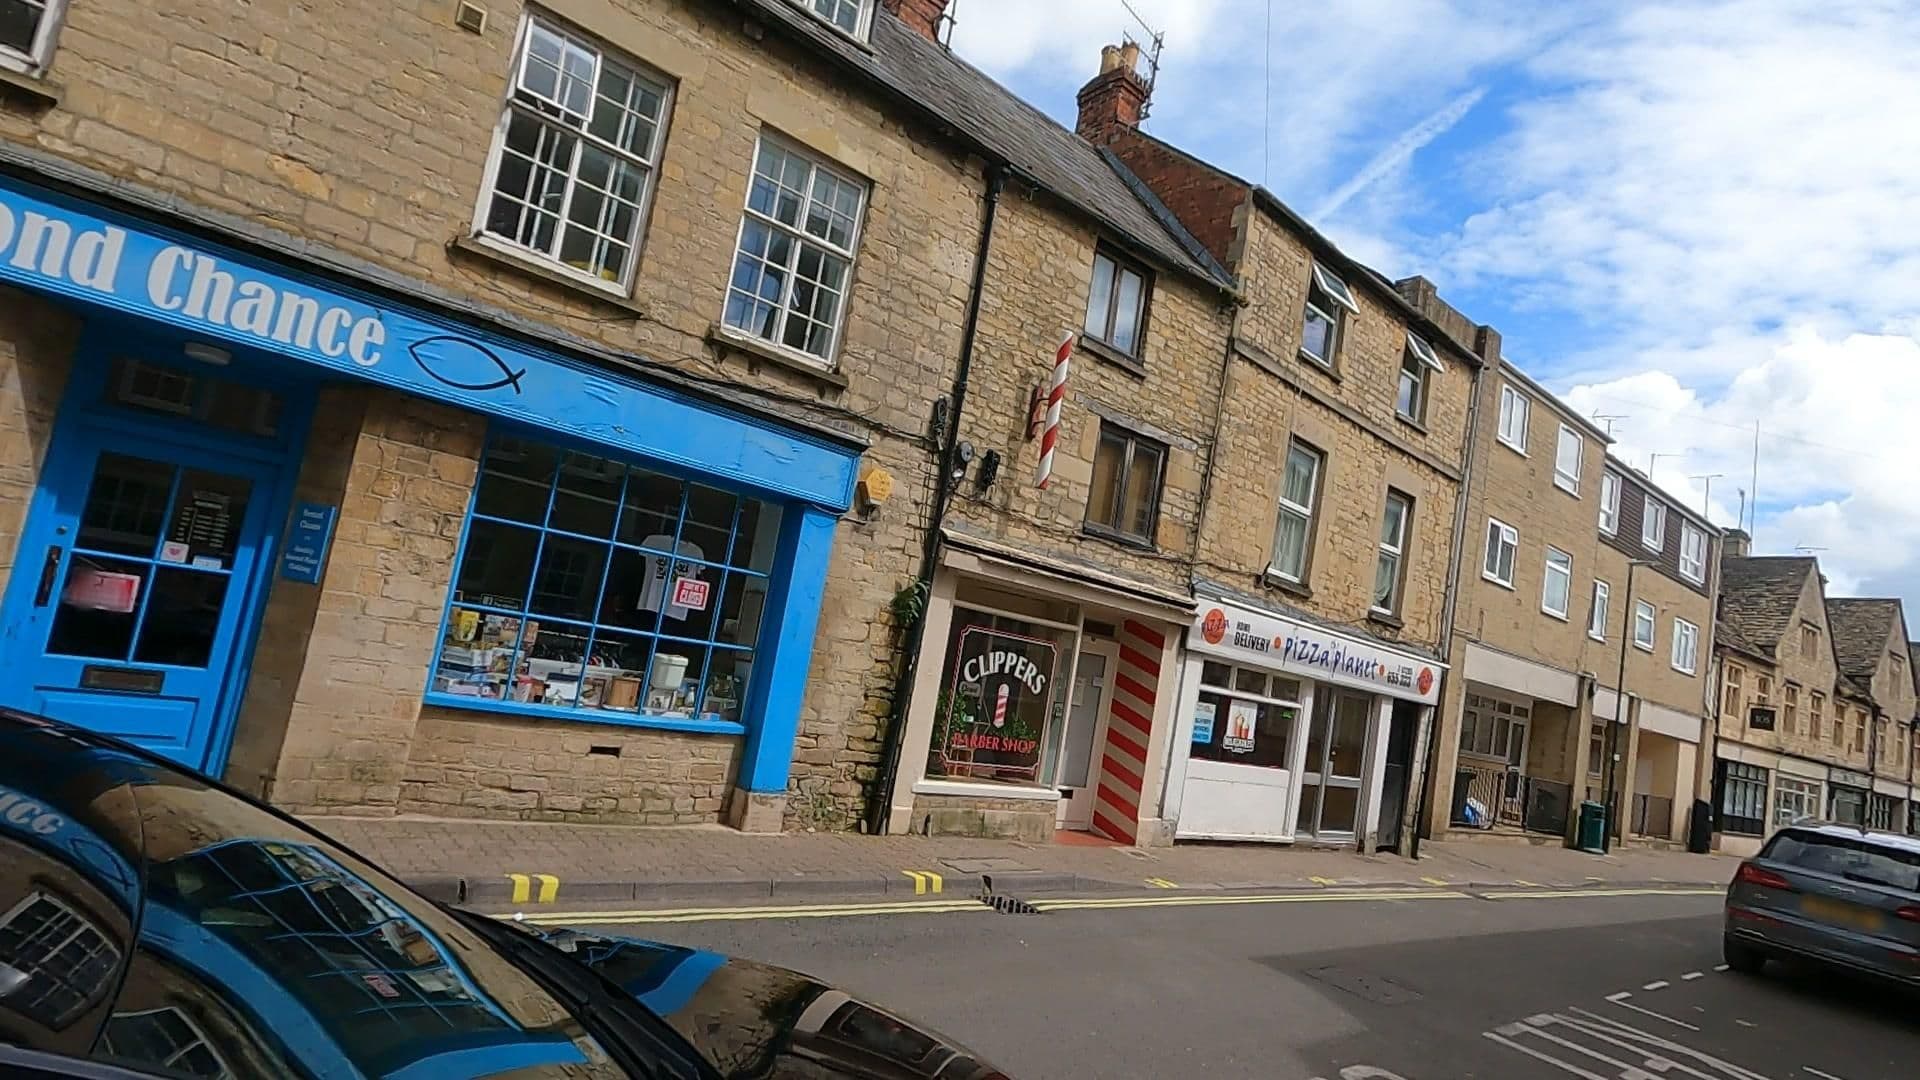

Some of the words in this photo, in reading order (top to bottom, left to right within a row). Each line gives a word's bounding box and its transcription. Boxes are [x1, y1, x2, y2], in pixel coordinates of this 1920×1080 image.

[147, 243, 386, 367] Chance
[1233, 632, 1271, 652] DELIVERY
[963, 651, 1046, 695] CLIPPERS
[952, 731, 1001, 751] BARBER
[1001, 737, 1038, 755] SHOP
